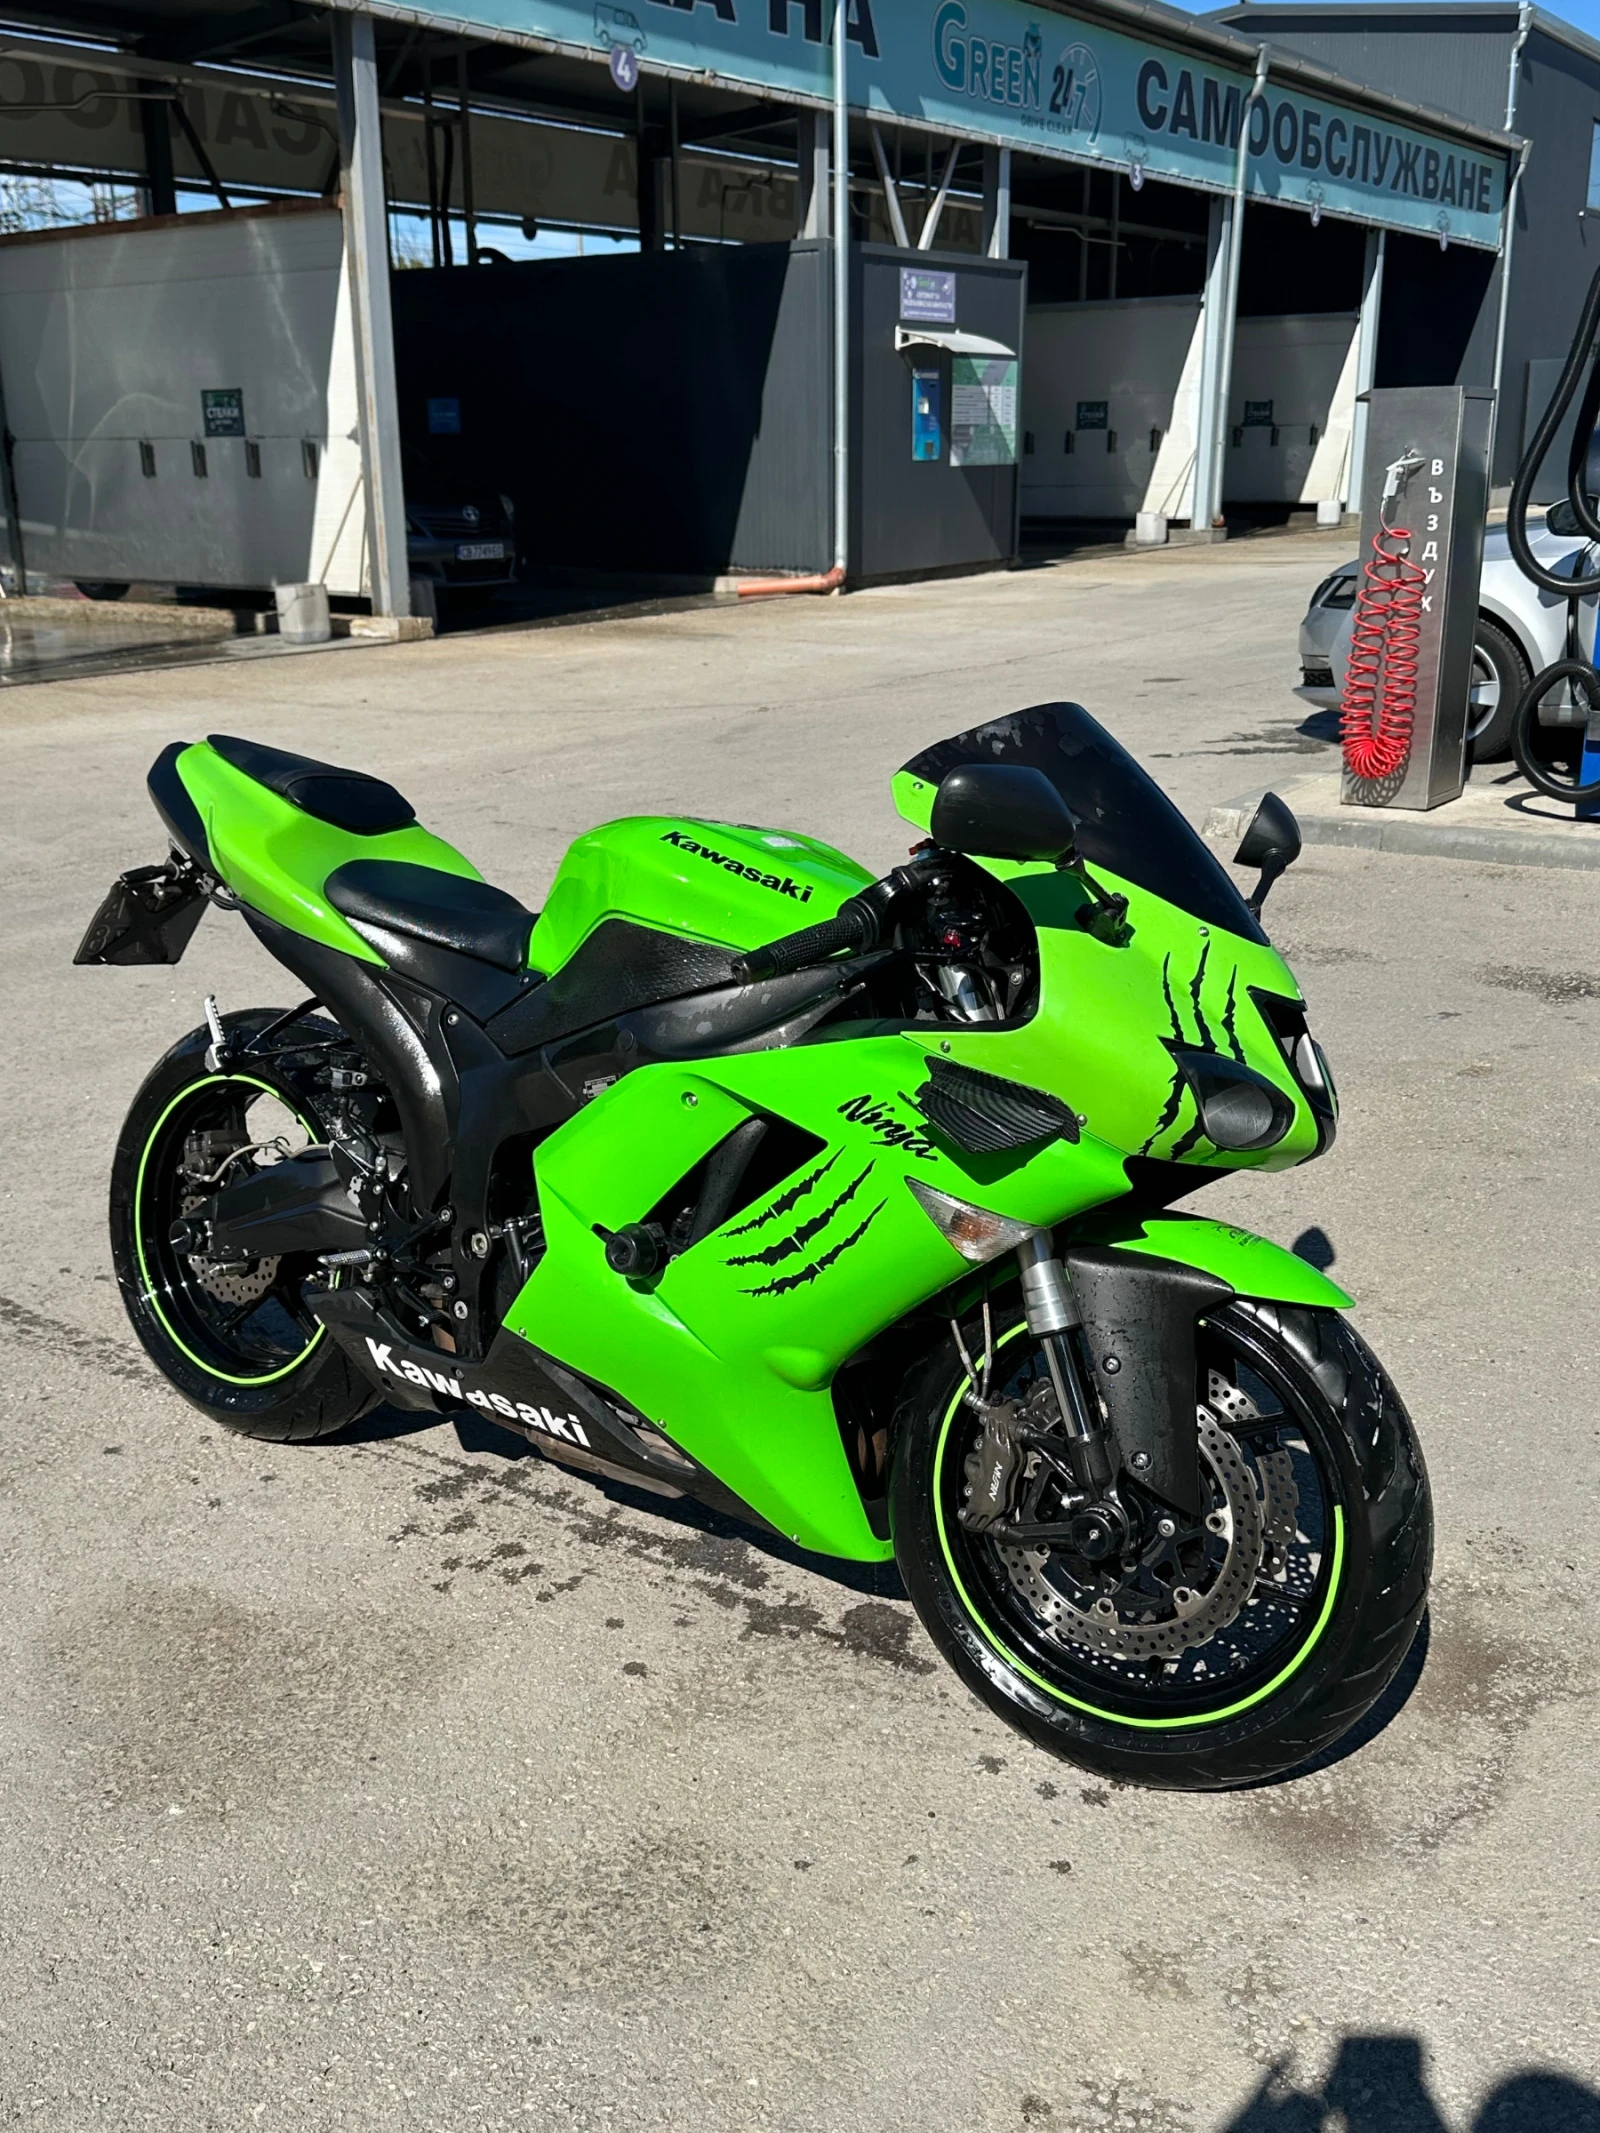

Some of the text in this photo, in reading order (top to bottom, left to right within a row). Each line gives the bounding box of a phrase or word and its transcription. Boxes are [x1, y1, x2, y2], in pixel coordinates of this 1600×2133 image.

[616, 51, 631, 84] 4
[1136, 58, 1492, 215] САМООБСЛУЖВАНЕ
[1132, 166, 1142, 186] 3
[658, 830, 815, 904] Kawasaki
[836, 1094, 939, 1162] Ninja
[365, 1336, 592, 1448] Kawasaki
